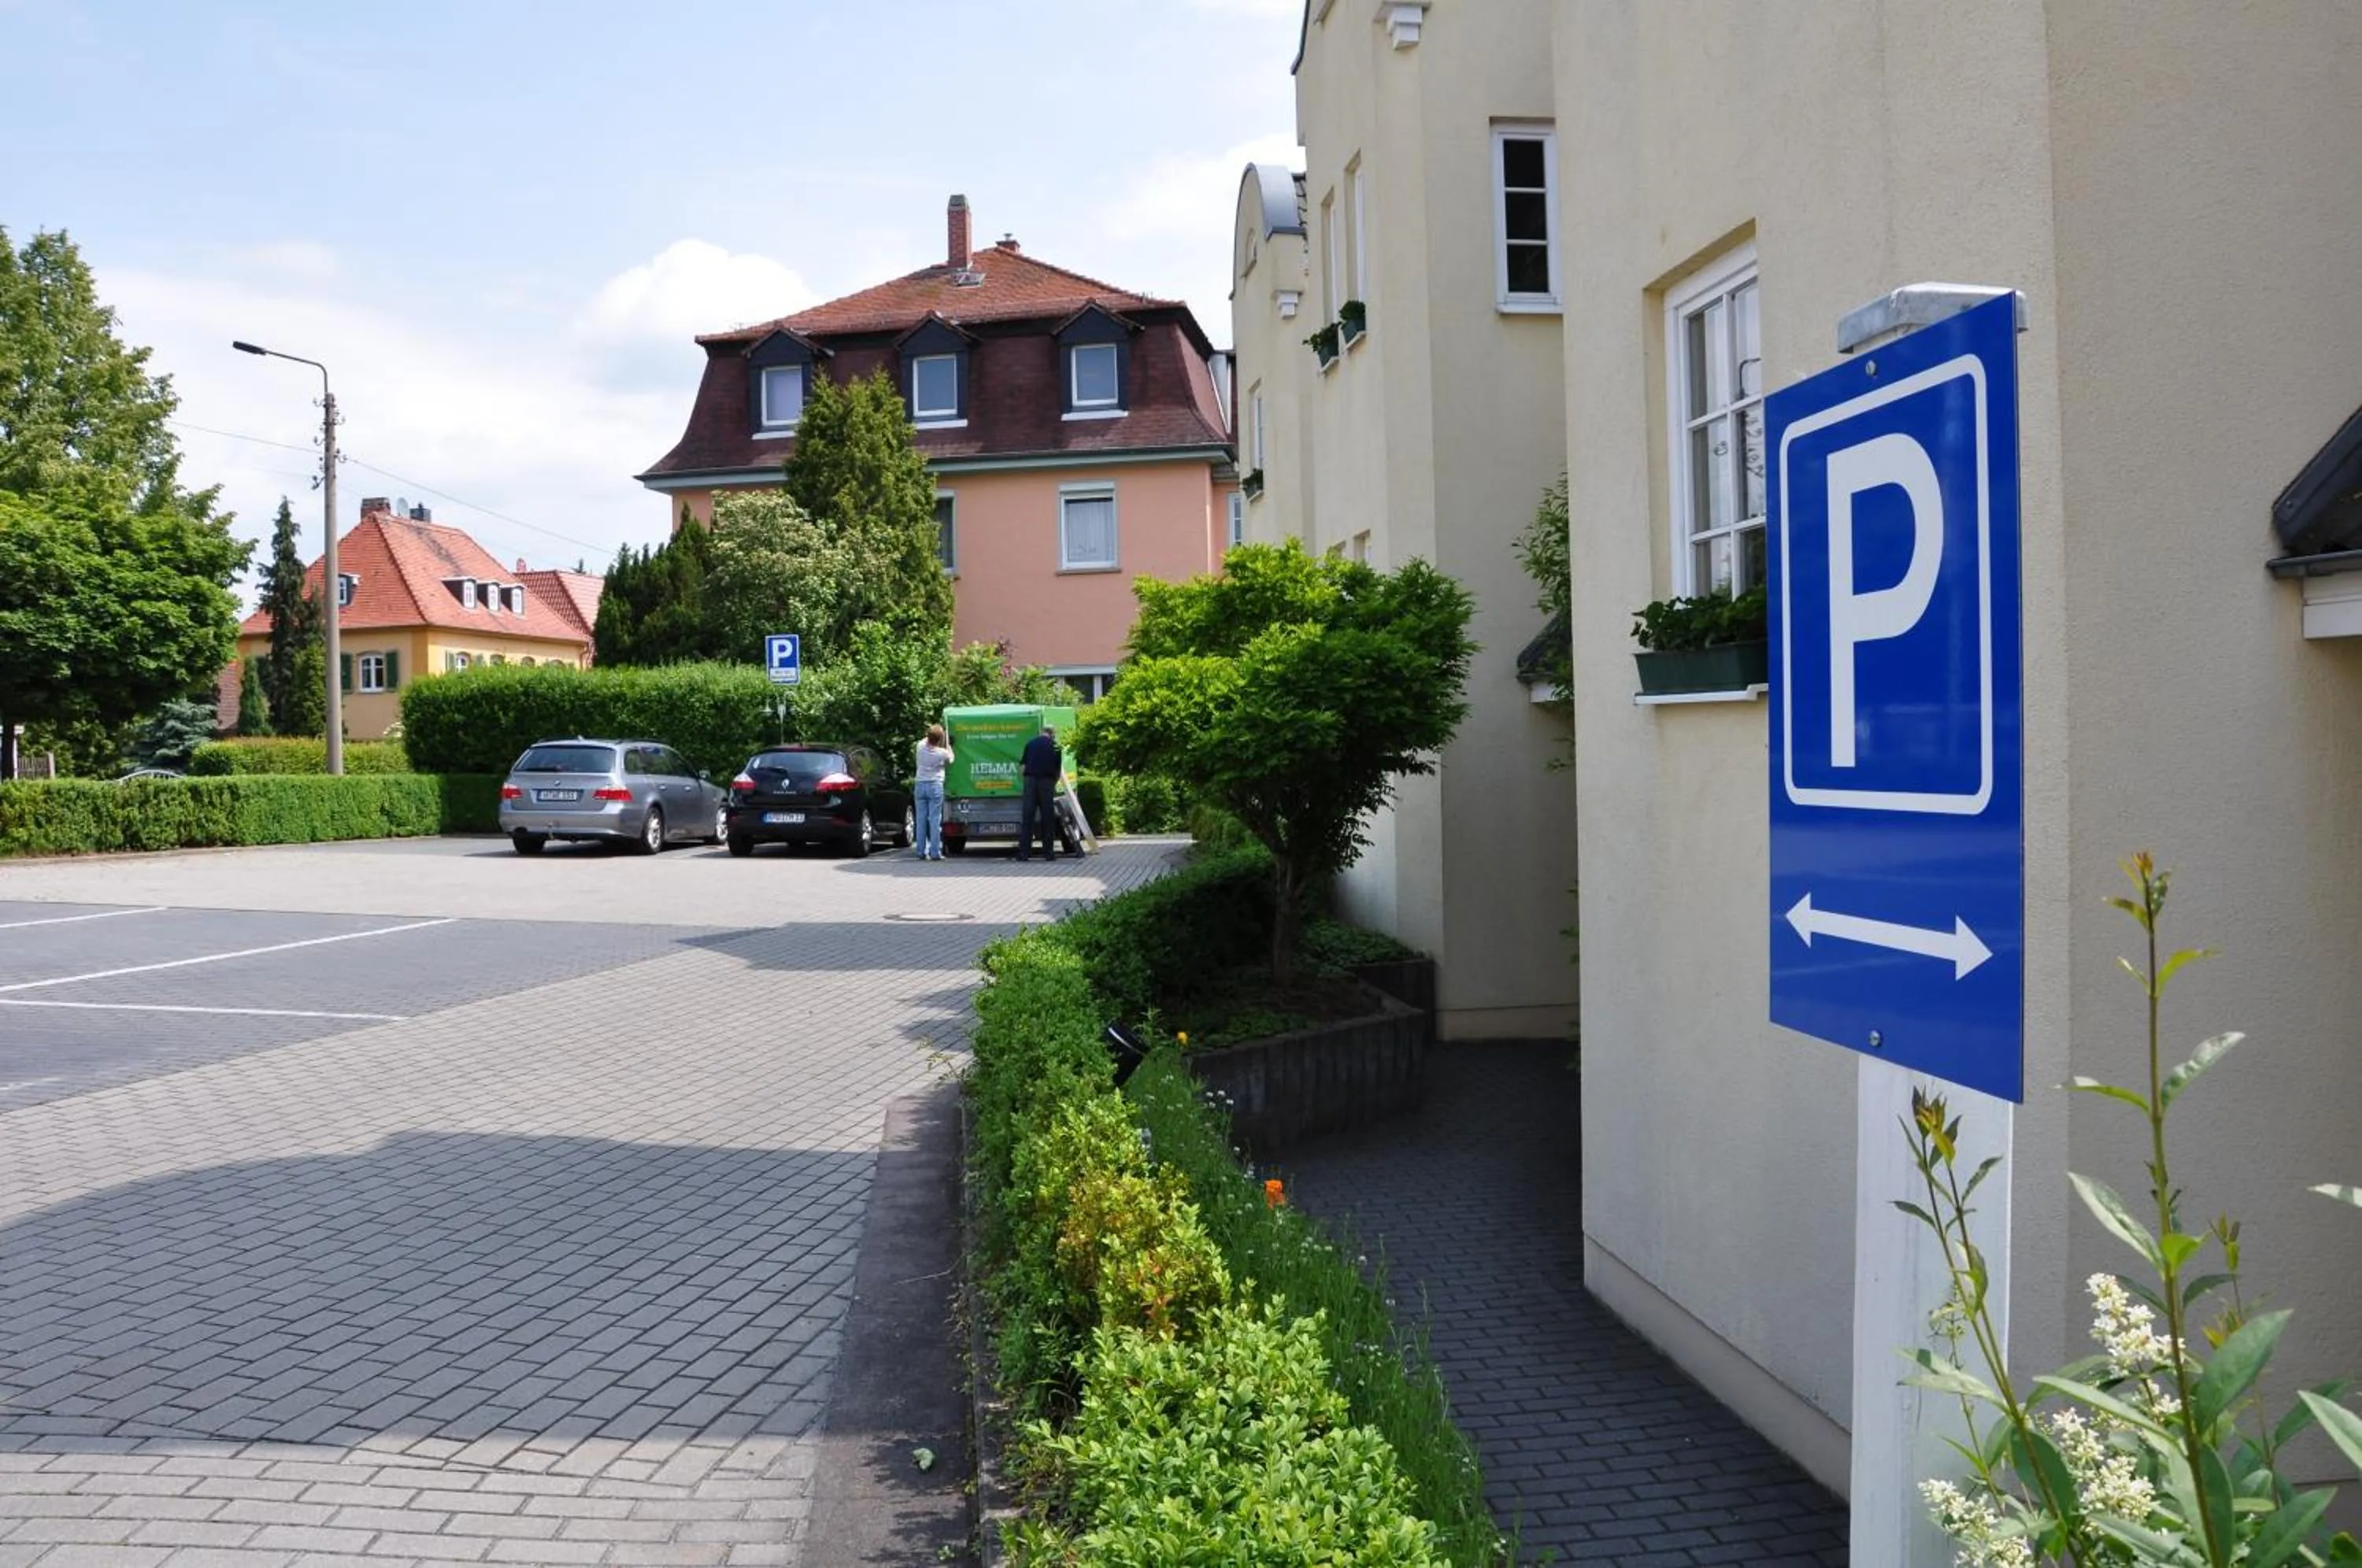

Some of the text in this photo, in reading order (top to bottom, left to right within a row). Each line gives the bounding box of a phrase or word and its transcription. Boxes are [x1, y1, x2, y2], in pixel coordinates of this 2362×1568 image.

[1827, 432, 1945, 767] P
[771, 638, 793, 668] P
[970, 762, 1017, 774] HELMA
